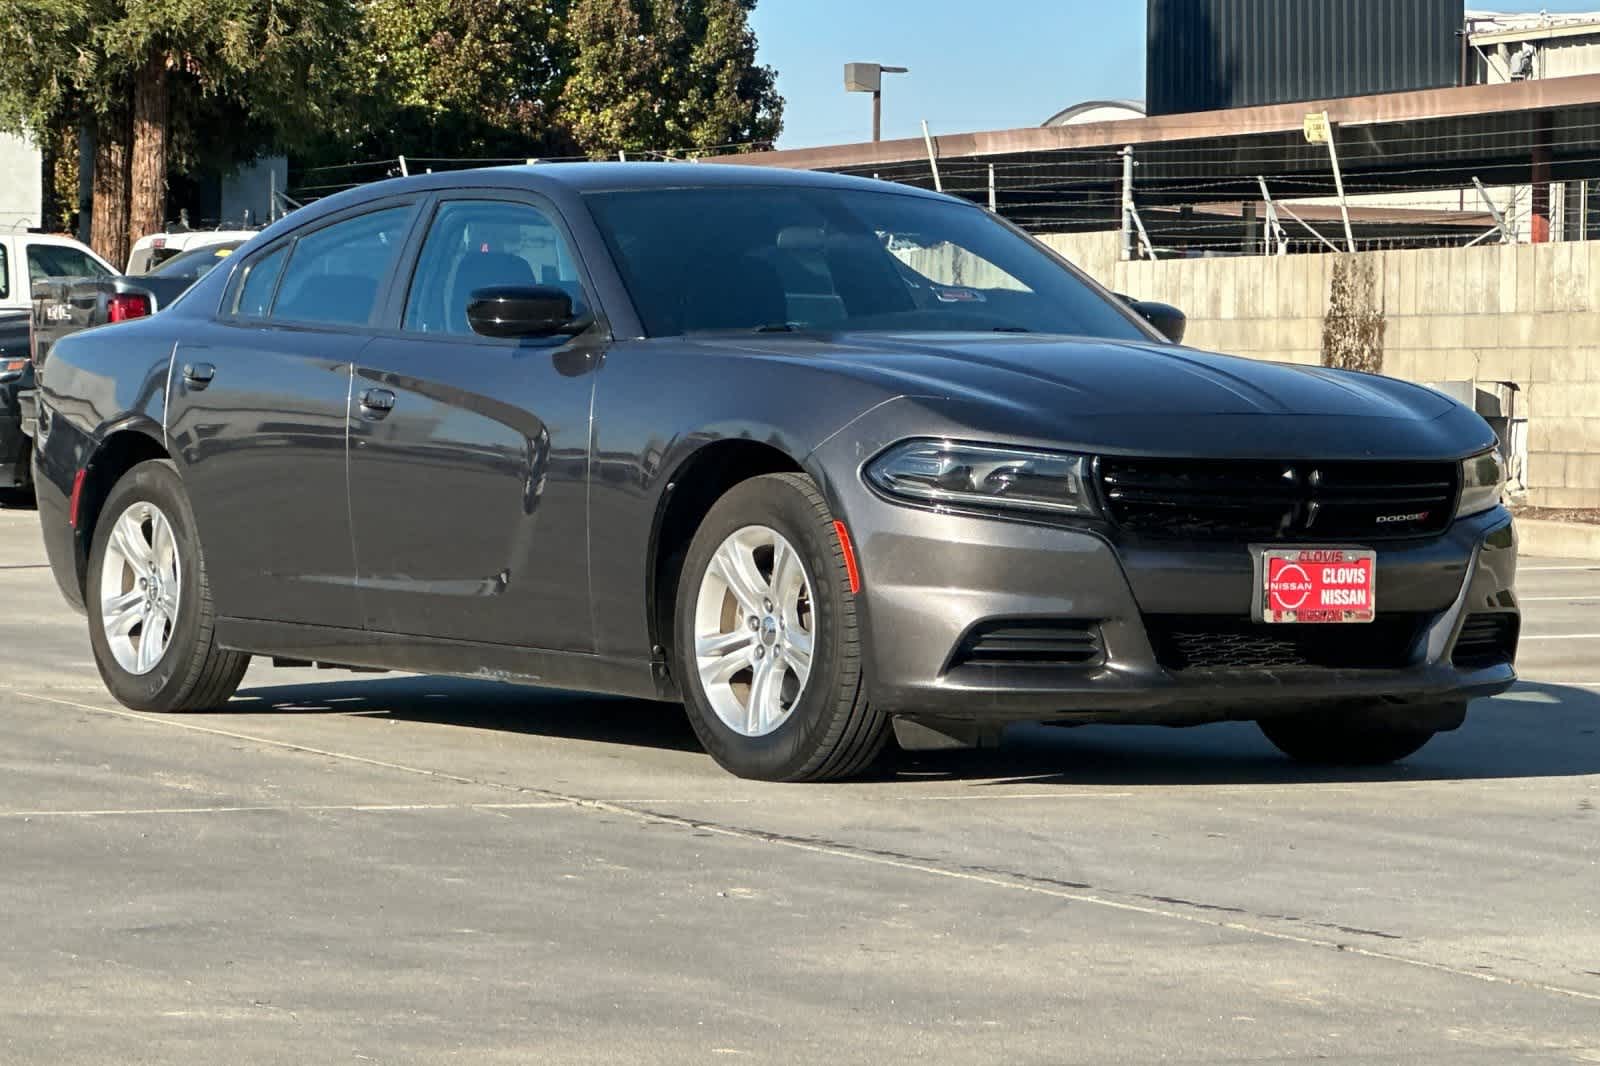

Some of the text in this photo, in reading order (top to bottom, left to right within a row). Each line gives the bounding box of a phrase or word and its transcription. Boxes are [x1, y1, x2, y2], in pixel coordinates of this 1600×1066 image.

[1376, 514, 1424, 523] DODGE
[1298, 551, 1344, 562] CLOVIS
[1322, 568, 1366, 584] CLOVIS
[1270, 582, 1312, 590] NISSAN
[1321, 589, 1366, 605] NISSAN
